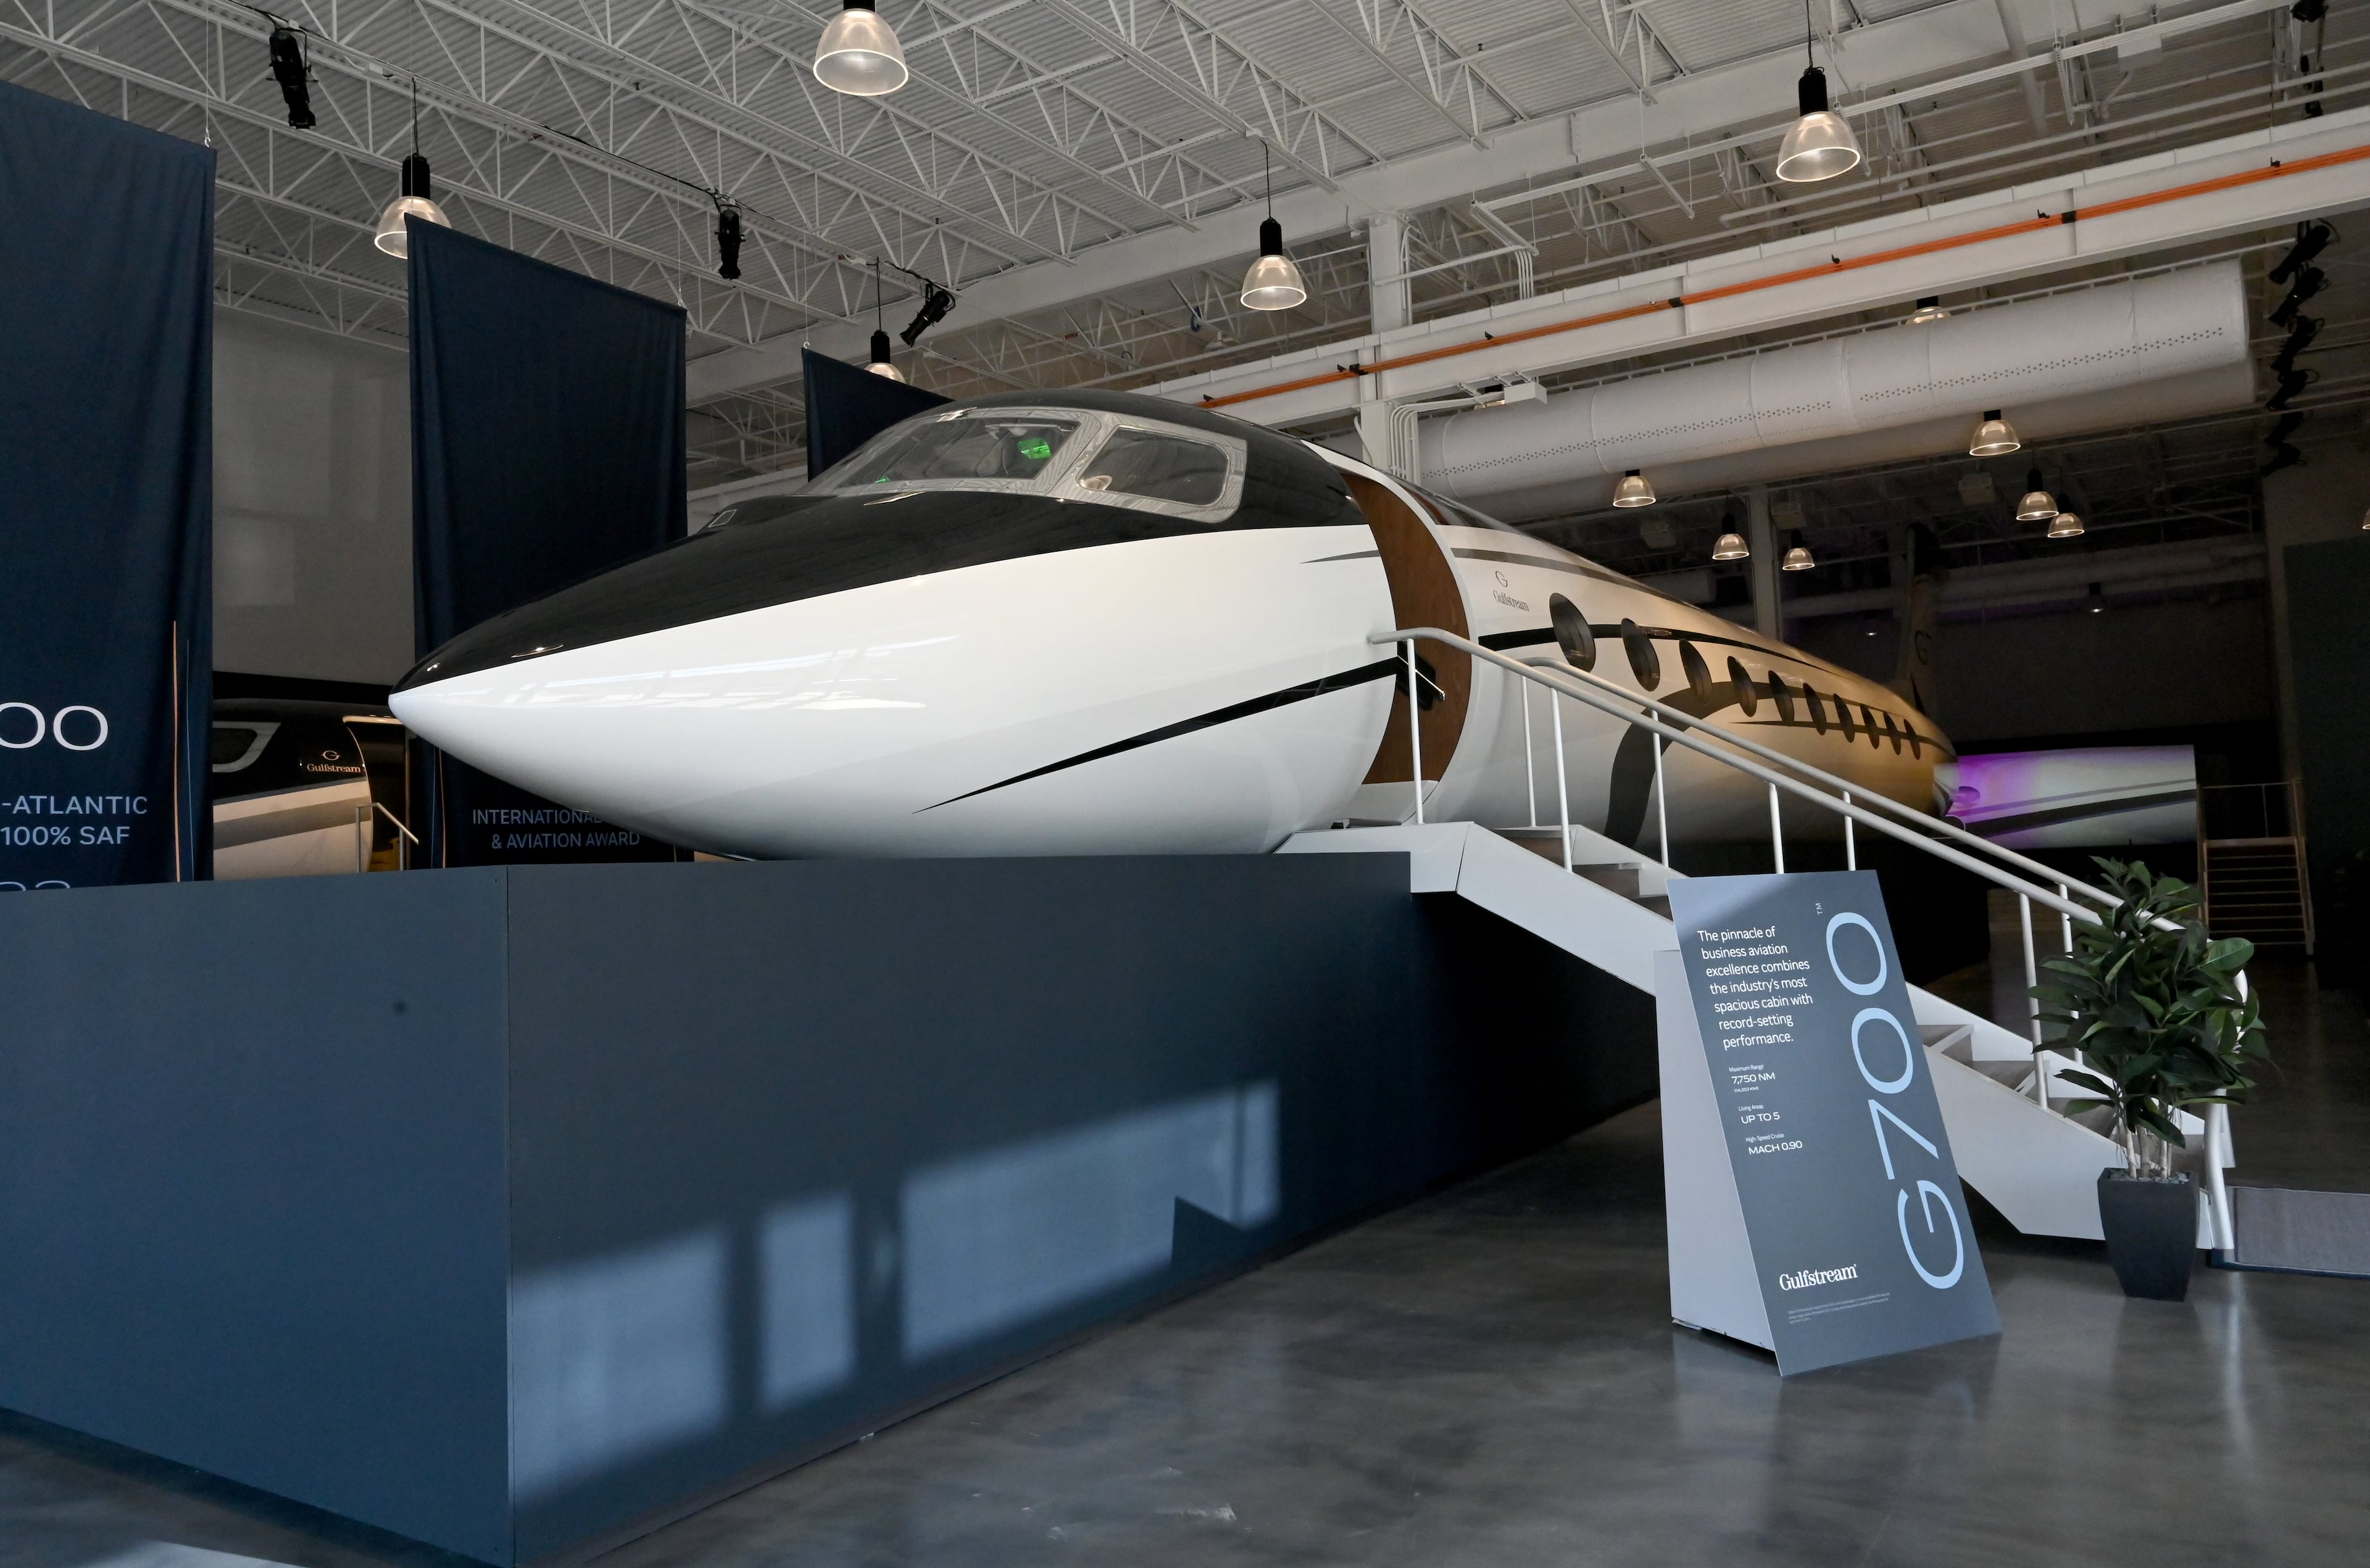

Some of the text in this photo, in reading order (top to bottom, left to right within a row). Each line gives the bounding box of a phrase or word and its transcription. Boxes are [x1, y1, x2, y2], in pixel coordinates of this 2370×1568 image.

[1493, 589, 1529, 612] Gulfstream
[307, 763, 361, 773] Gulfstream
[0, 826, 130, 845] 100% SAF
[491, 831, 641, 849] & AVIATION AWARD
[1697, 926, 1776, 944] The pinnacle of
[1701, 944, 1789, 960] business aviation
[1706, 960, 1810, 977] excellence combines
[1710, 977, 1808, 995] the industry's most
[1714, 993, 1813, 1015] spacious cabin with
[1718, 1014, 1794, 1031] record-setting
[1723, 1032, 1794, 1052] performance.
[1731, 1072, 1776, 1085] 7,750 NM
[1826, 912, 1964, 1289] G700
[1740, 1111, 1781, 1124] UP TO 5
[1748, 1140, 1803, 1155] MACH 0.90
